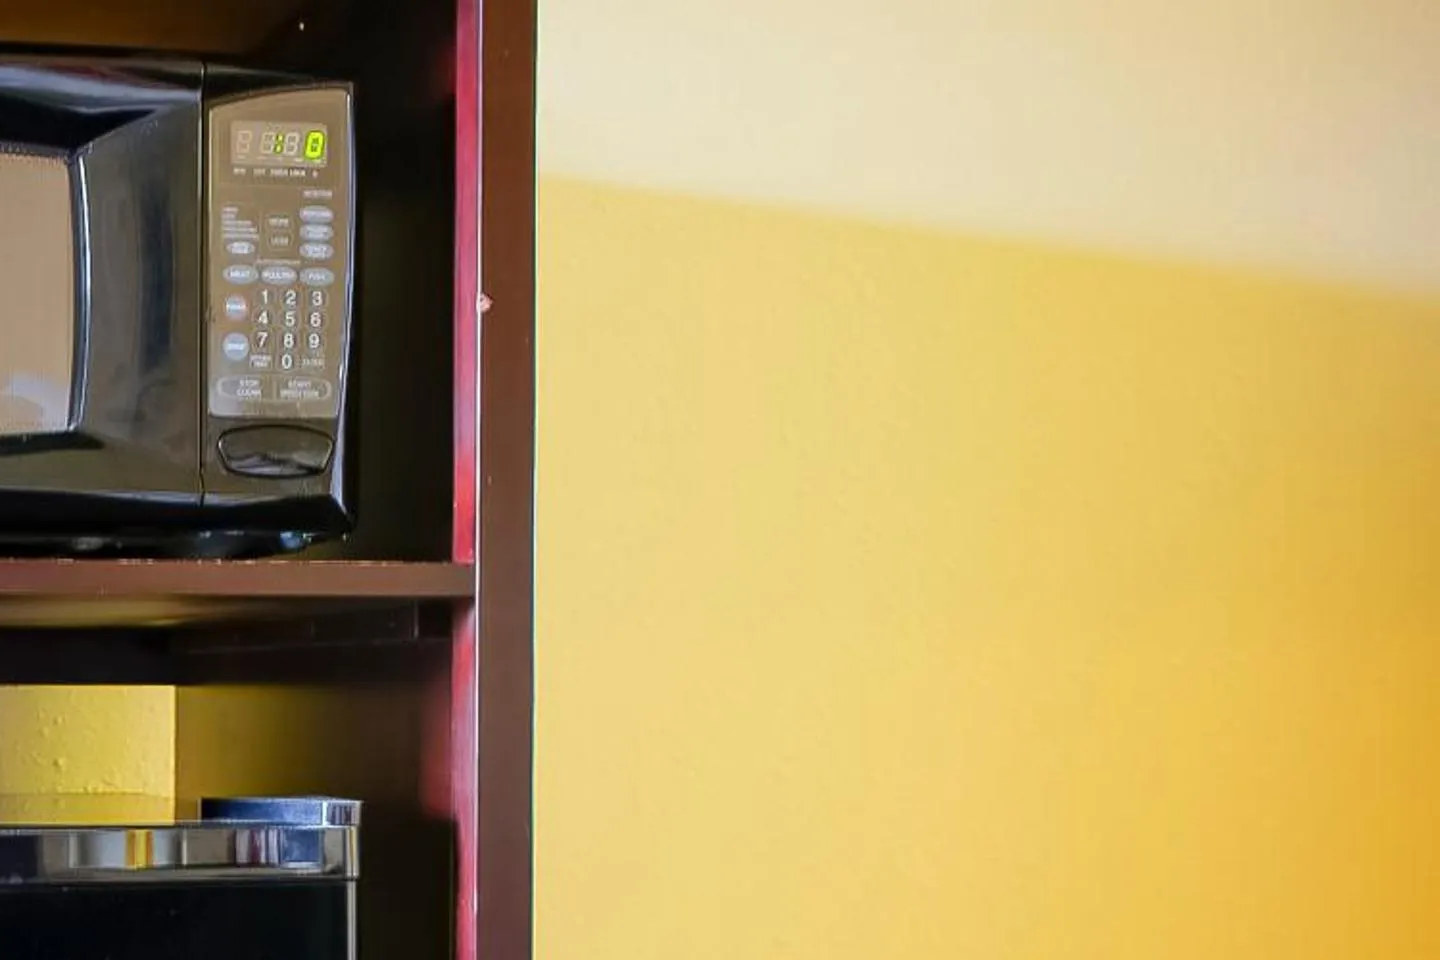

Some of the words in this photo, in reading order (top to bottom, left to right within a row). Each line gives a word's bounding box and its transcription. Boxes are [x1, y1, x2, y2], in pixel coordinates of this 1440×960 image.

[261, 289, 268, 304] 1
[285, 290, 297, 305] 2
[312, 291, 322, 306] 3
[258, 312, 268, 324] 4
[285, 311, 295, 327] 5
[310, 312, 321, 327] 6
[258, 332, 268, 347] 7
[283, 333, 294, 348] 8
[308, 333, 320, 349] 9
[281, 354, 292, 369] 0
